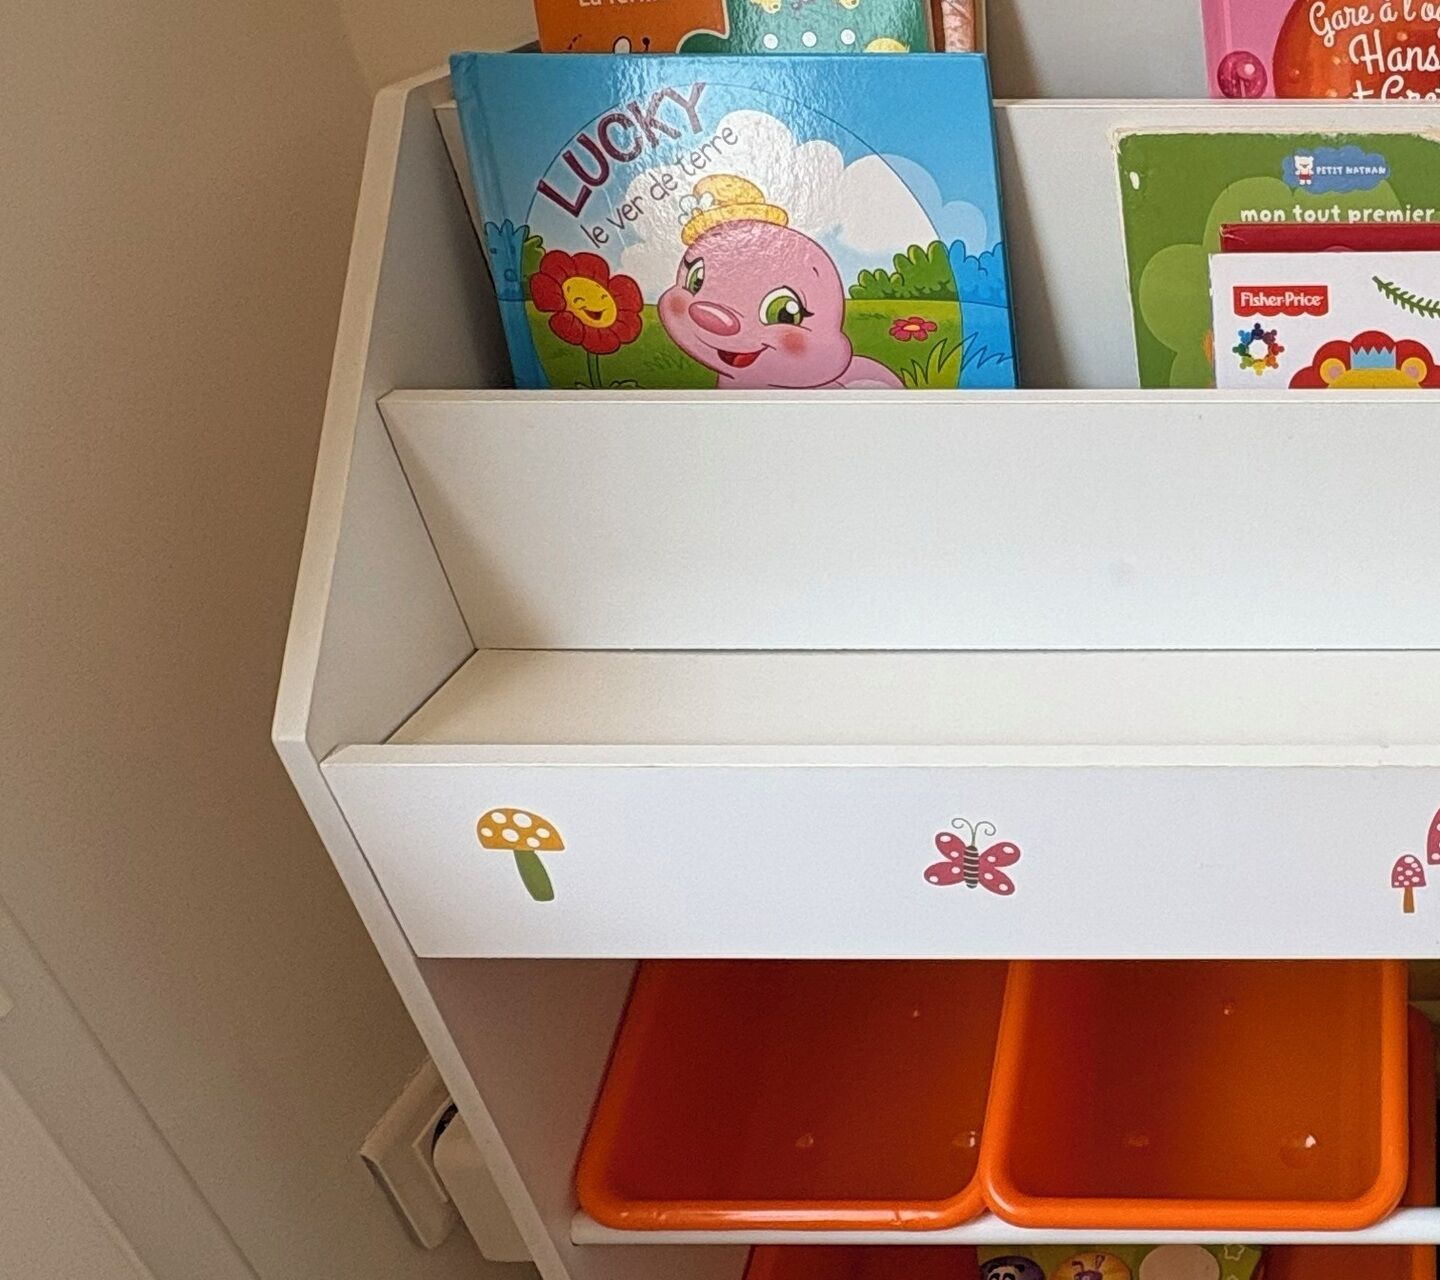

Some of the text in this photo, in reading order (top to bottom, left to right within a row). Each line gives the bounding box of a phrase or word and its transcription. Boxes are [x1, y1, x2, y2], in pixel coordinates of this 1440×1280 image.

[1310, 1, 1374, 48] Gare
[536, 81, 707, 218] LUCKY
[580, 125, 738, 249] le ver de terre
[1315, 166, 1387, 176] PETIT NATHAN
[1240, 208, 1286, 222] mon
[1293, 205, 1341, 222] tout
[1240, 291, 1322, 307] Fisher-Price
